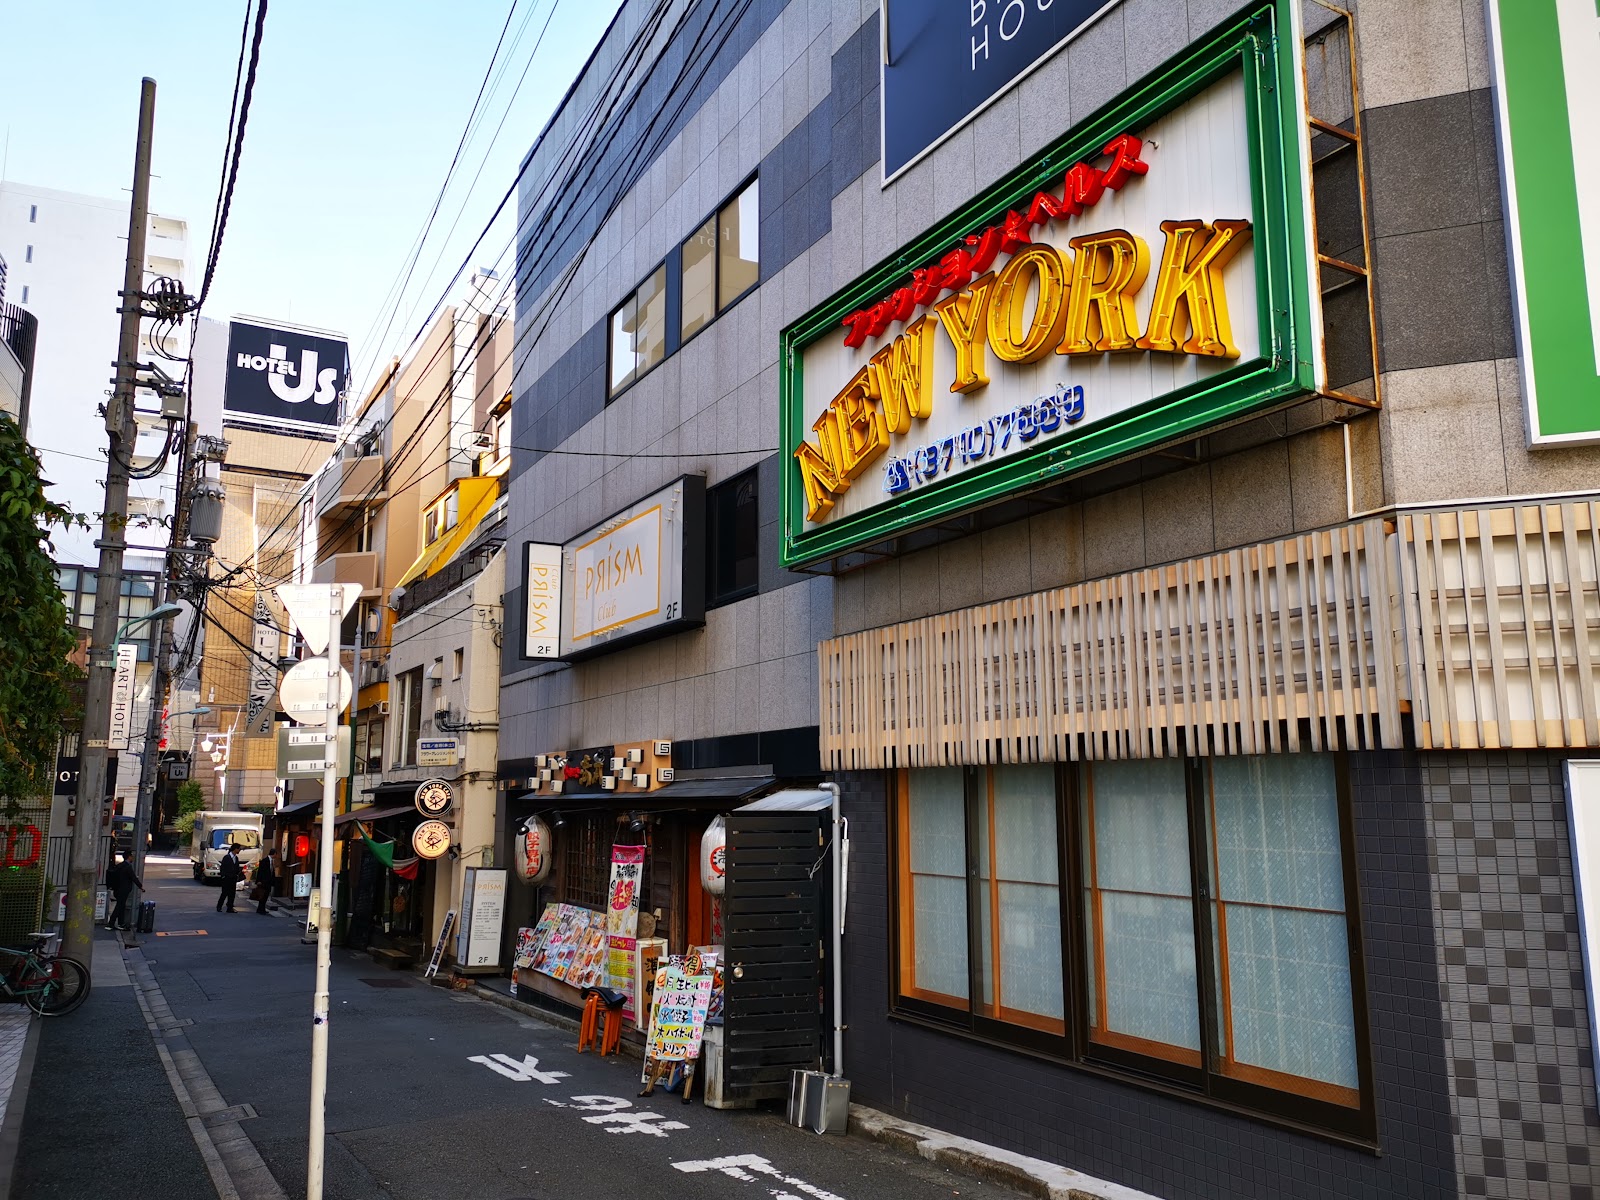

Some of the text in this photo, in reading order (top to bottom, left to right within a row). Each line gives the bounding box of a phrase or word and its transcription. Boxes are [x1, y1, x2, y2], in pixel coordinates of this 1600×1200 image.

[236, 352, 298, 377] HOTEL
[793, 217, 1254, 523] NEW YORK
[666, 601, 678, 621] 2F
[537, 645, 551, 655] 2F
[112, 649, 131, 744] HEART HOTEL
[420, 788, 428, 800] NEW
[442, 786, 452, 800] CAFE
[417, 829, 426, 840] NEW
[441, 828, 449, 840] CAFE
[478, 956, 489, 964] 2F
[676, 976, 699, 991] 生ビール
[666, 1026, 694, 1039] ハイボール
[662, 1042, 688, 1057] ドリンク
